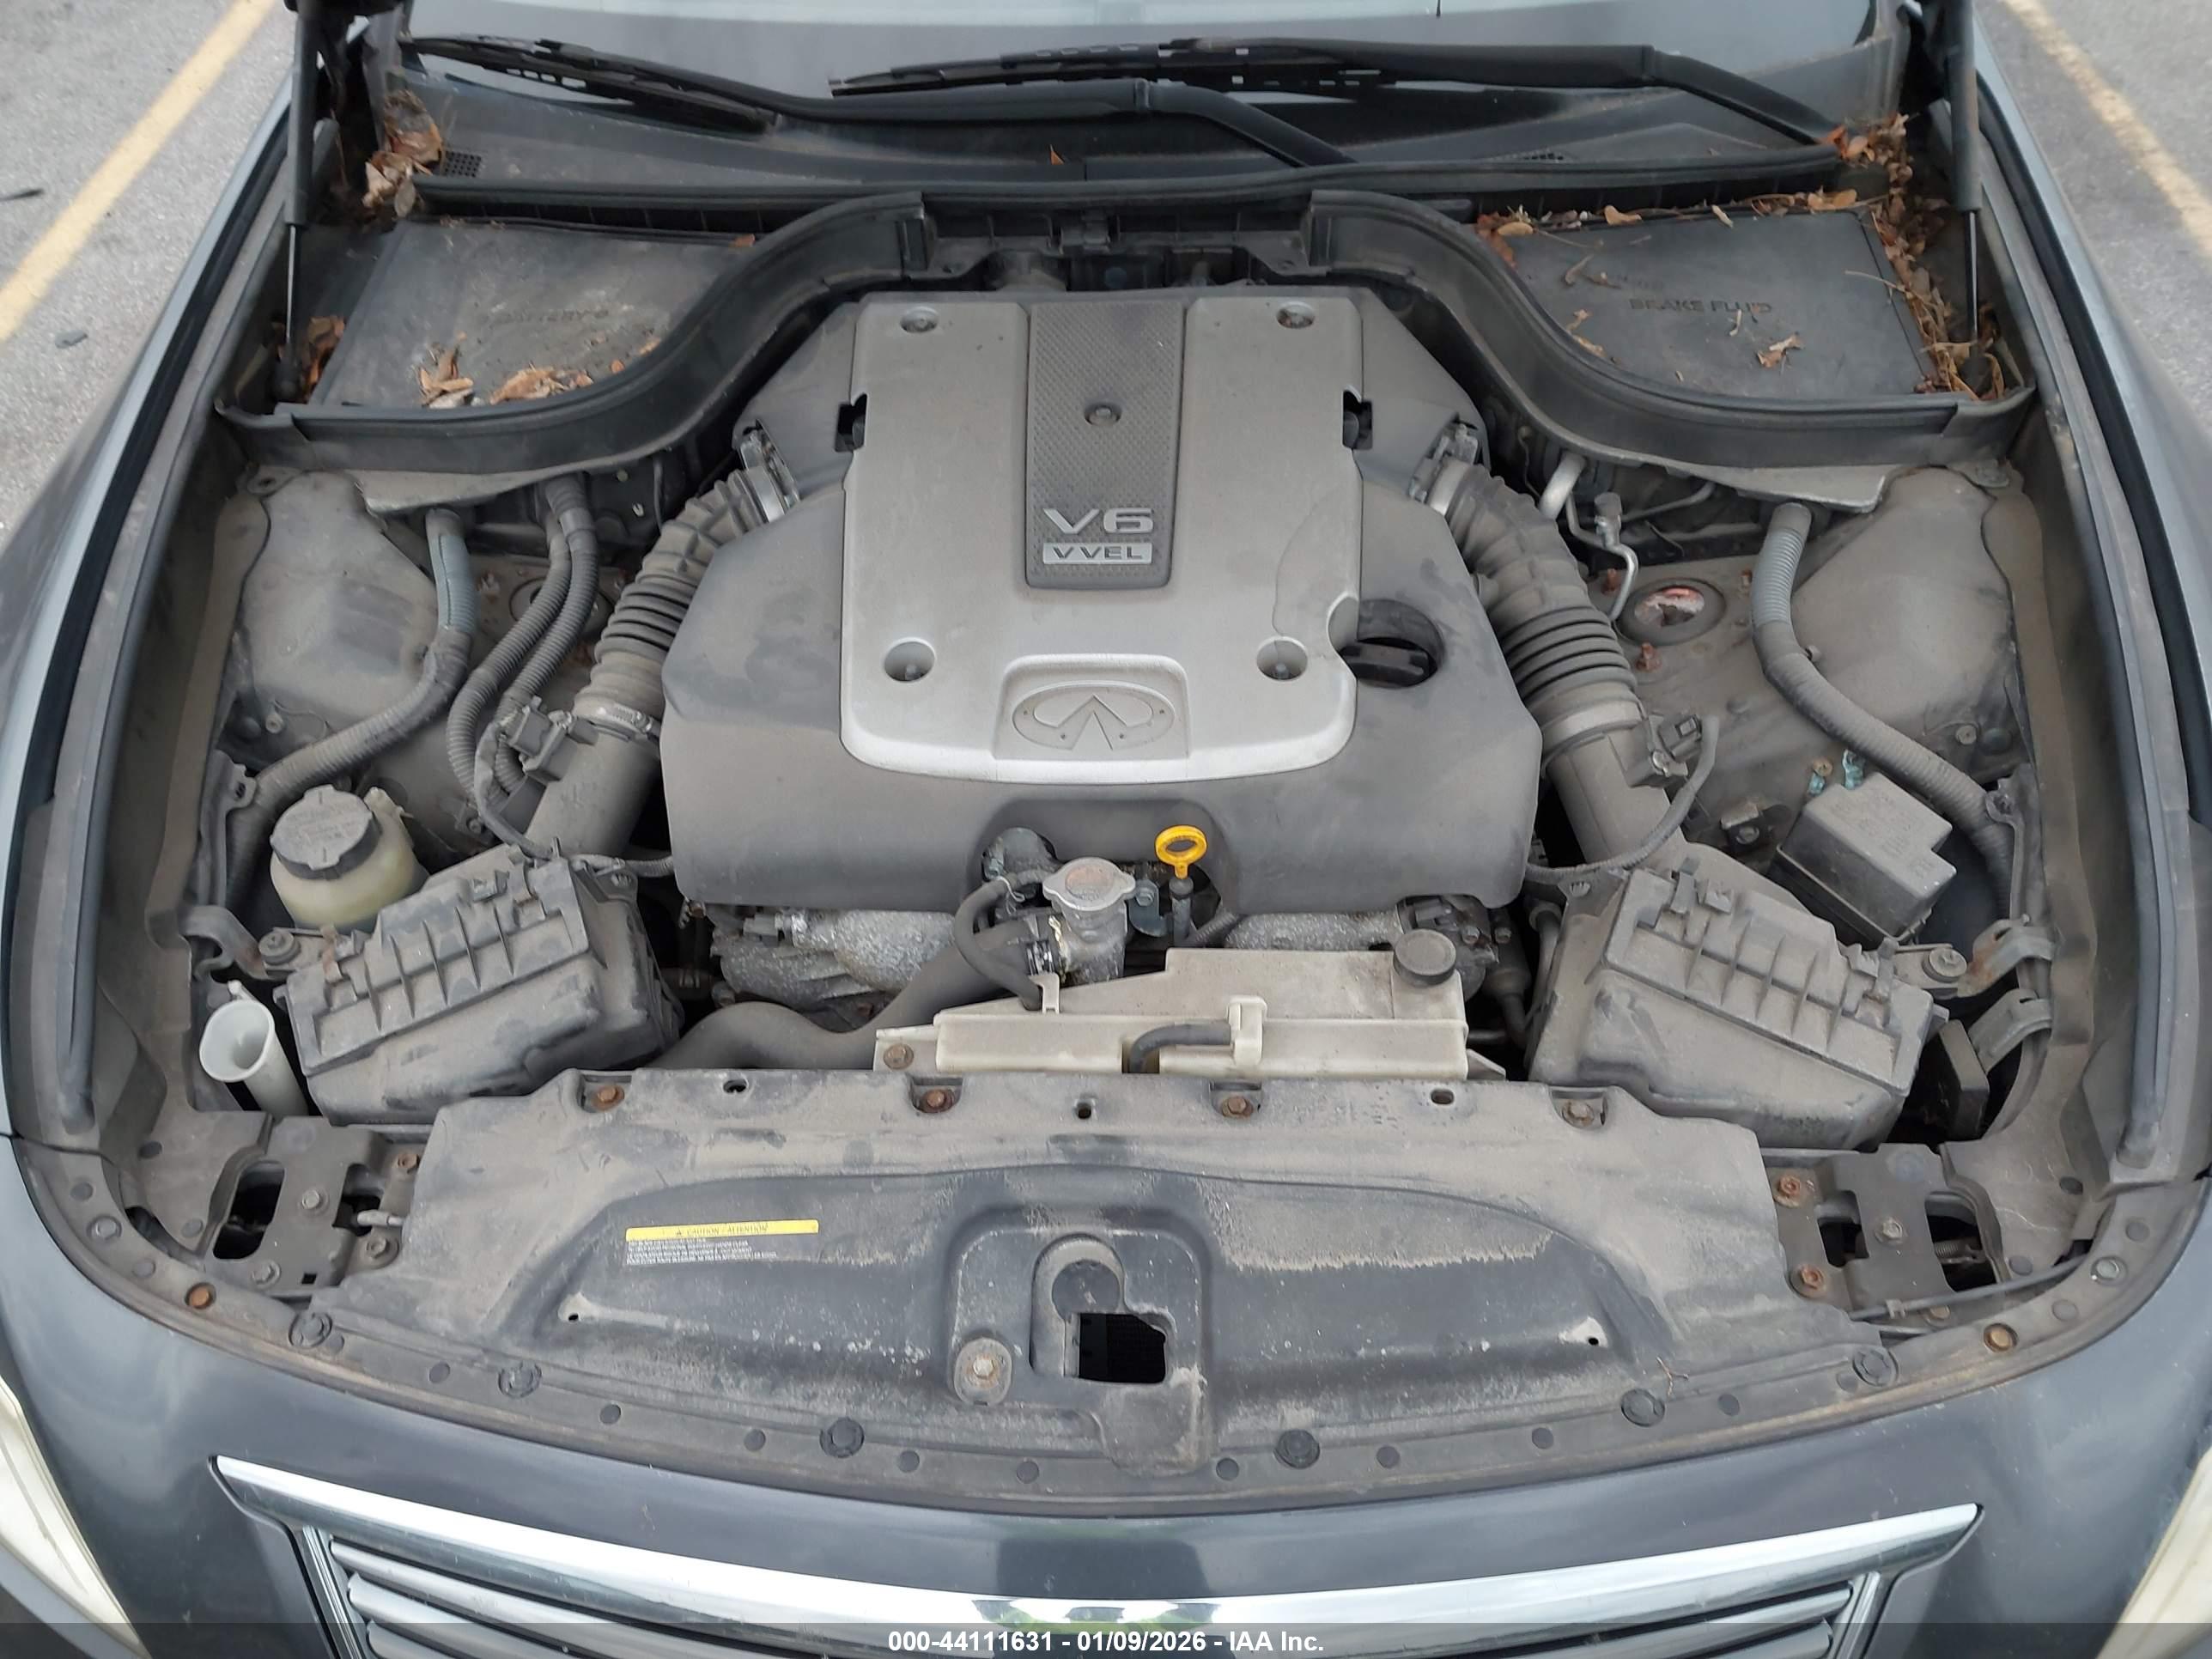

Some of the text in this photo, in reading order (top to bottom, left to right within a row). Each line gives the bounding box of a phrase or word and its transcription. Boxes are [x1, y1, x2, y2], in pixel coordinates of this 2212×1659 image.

[1628, 298, 1773, 314] BRAKE FLUID
[1042, 507, 1154, 535] V6
[1053, 546, 1142, 559] VVEL
